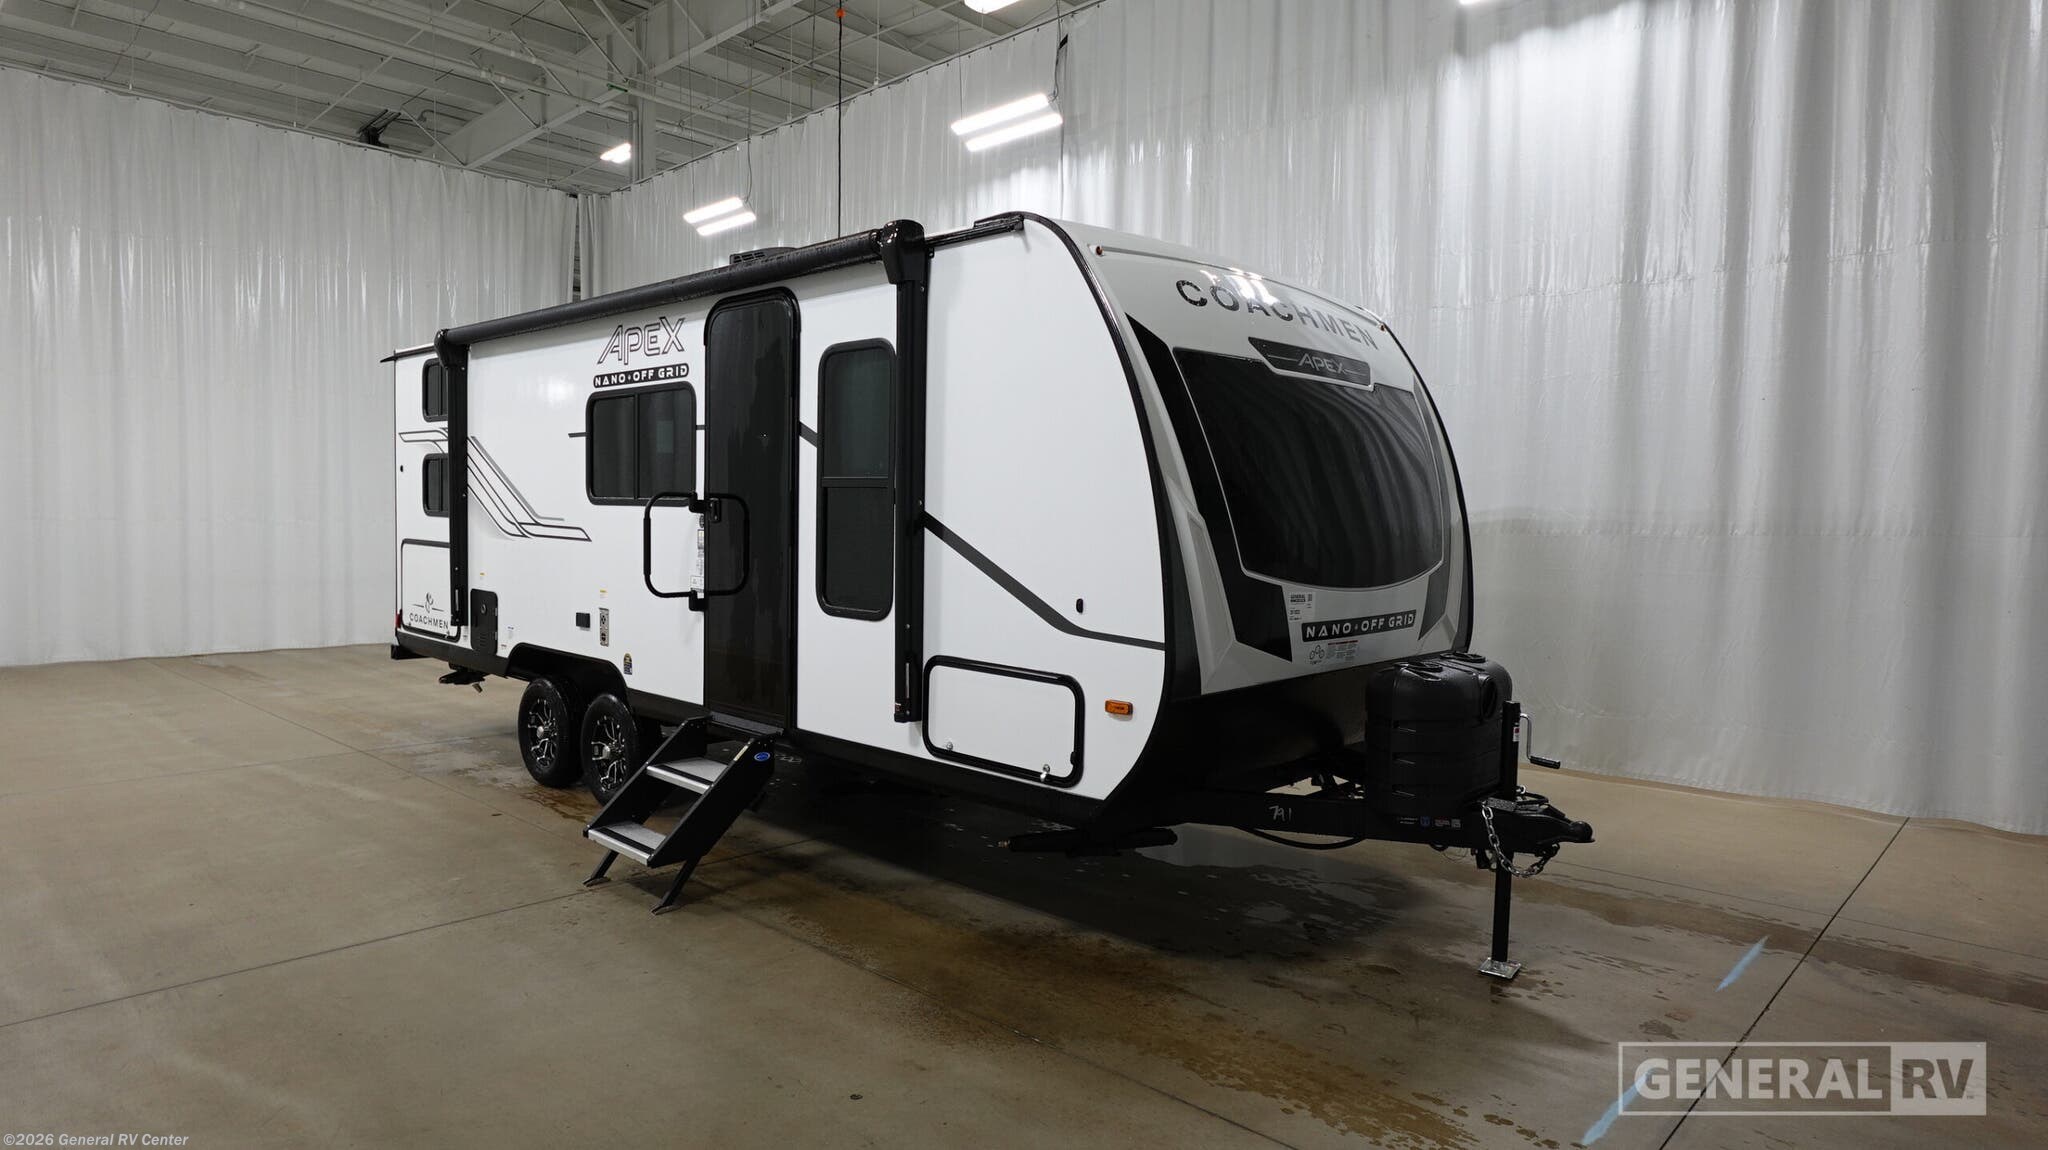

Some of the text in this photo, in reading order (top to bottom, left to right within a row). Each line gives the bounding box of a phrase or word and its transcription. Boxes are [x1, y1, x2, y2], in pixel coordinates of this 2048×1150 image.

[1176, 280, 1379, 349] COACHMEN
[597, 316, 686, 365] APEX
[595, 365, 688, 387] NANO OFF GRID
[1299, 353, 1346, 375] APEX
[409, 612, 449, 629] COACHMEN
[1306, 613, 1414, 639] NANO OFF GRID
